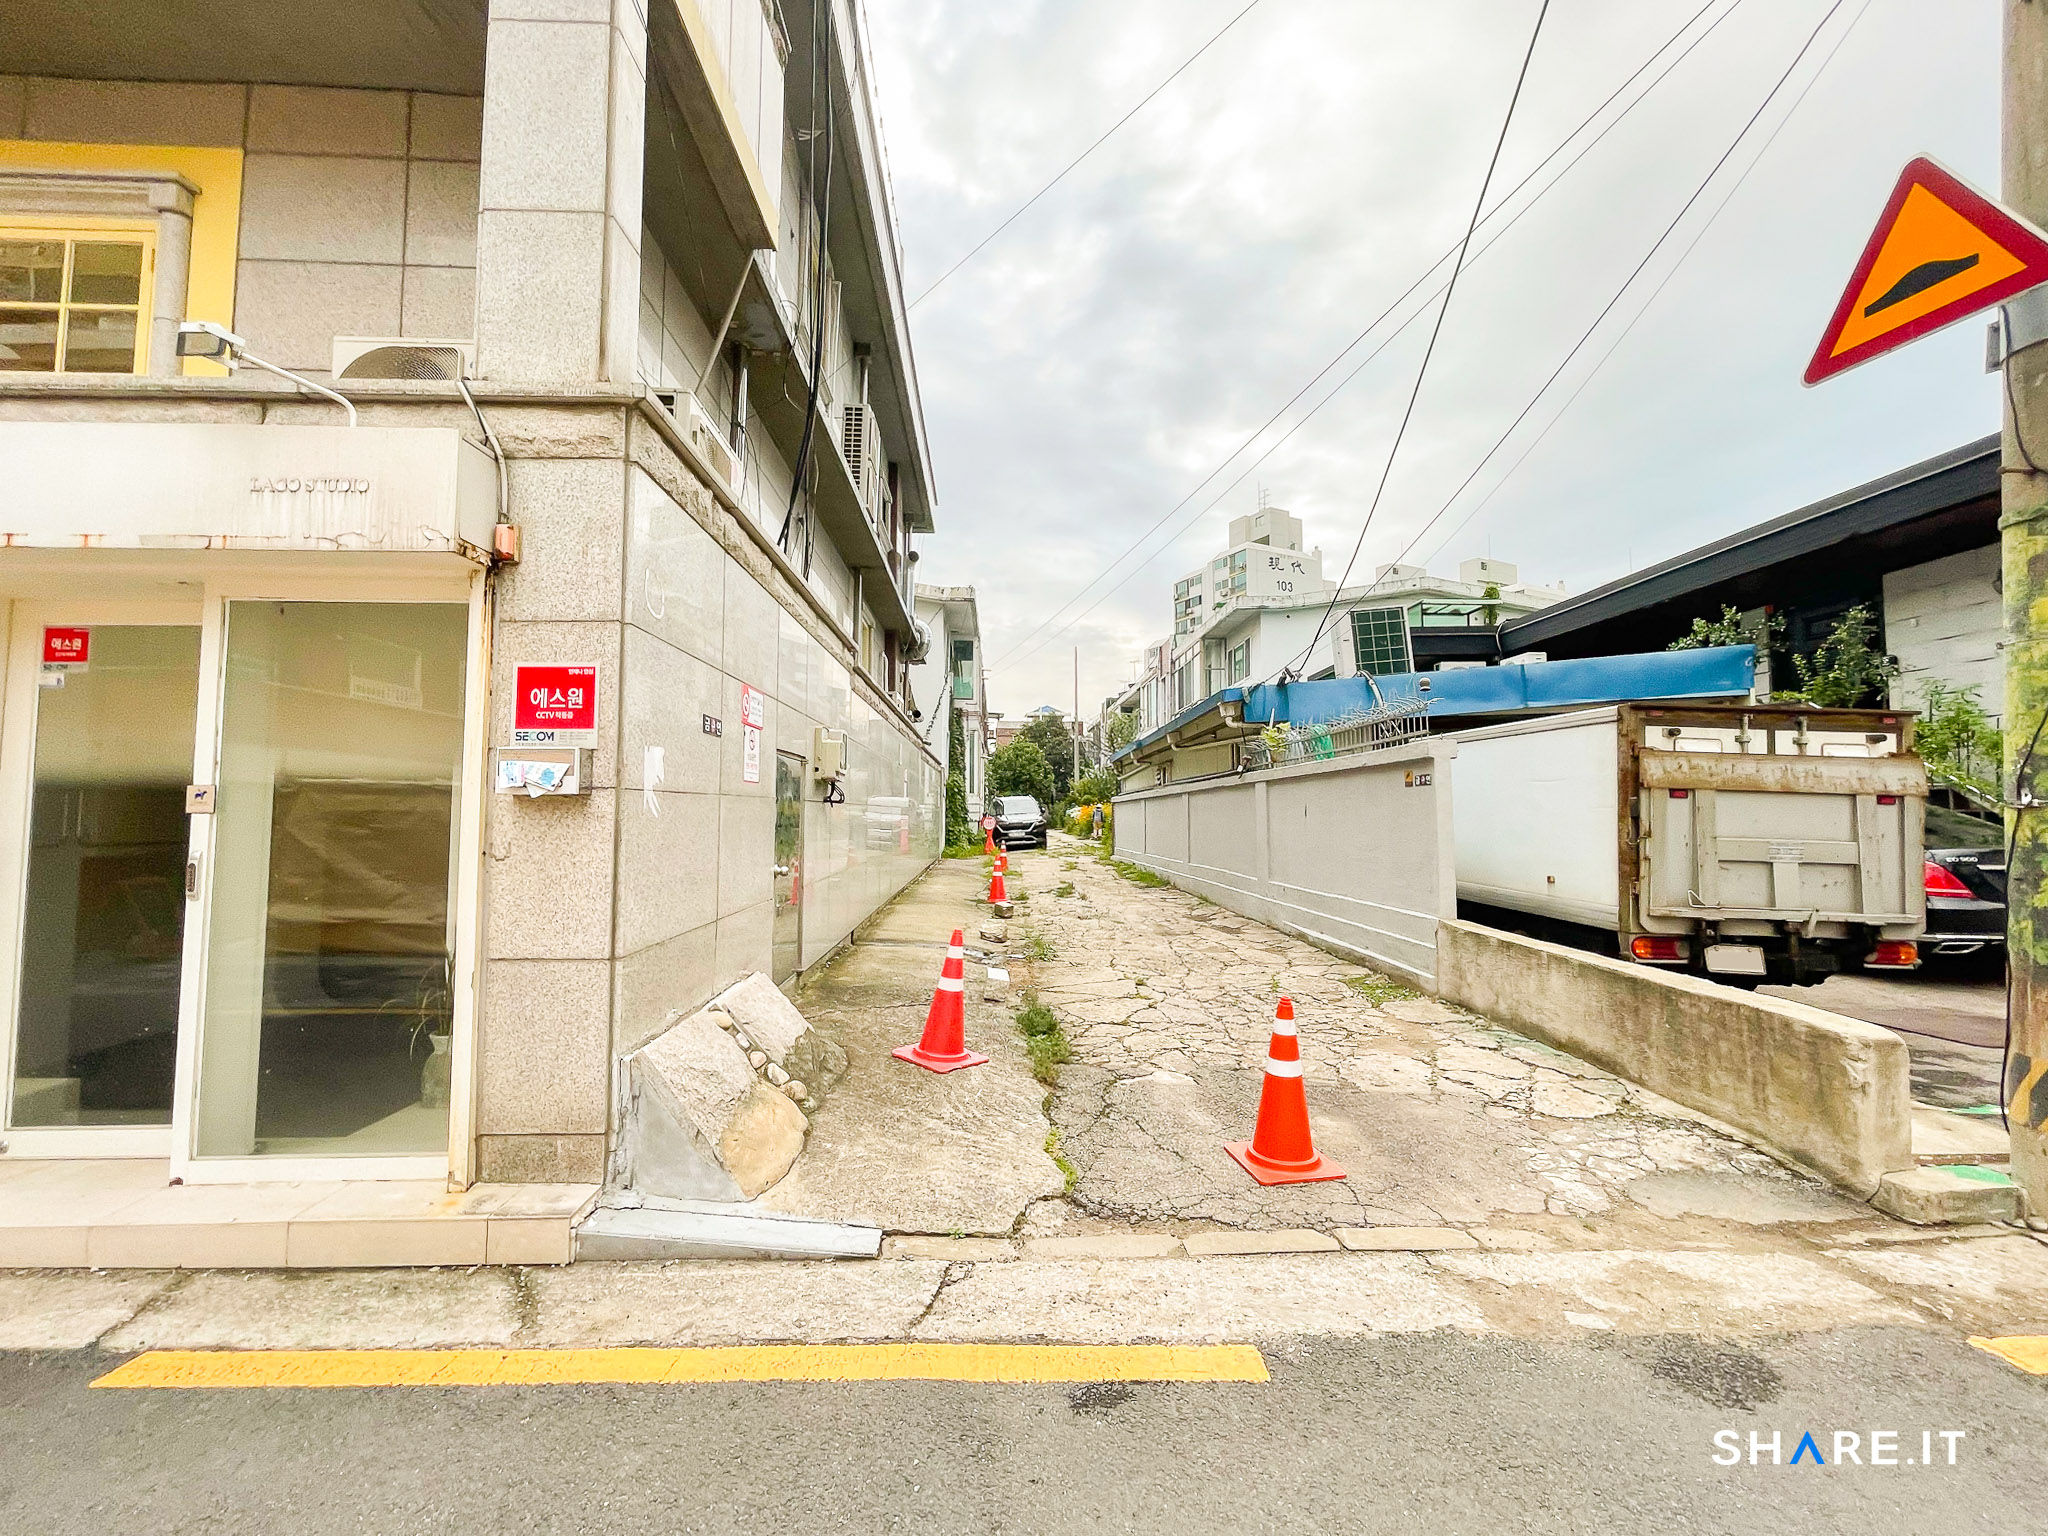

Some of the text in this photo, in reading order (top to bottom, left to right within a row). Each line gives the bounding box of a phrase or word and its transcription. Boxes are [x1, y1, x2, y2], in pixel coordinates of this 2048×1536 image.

[305, 478, 370, 494] STUDIO
[1276, 580, 1294, 593] 103
[530, 688, 583, 709] 에스원
[535, 711, 555, 719] CCTV
[515, 731, 555, 742] SECOM
